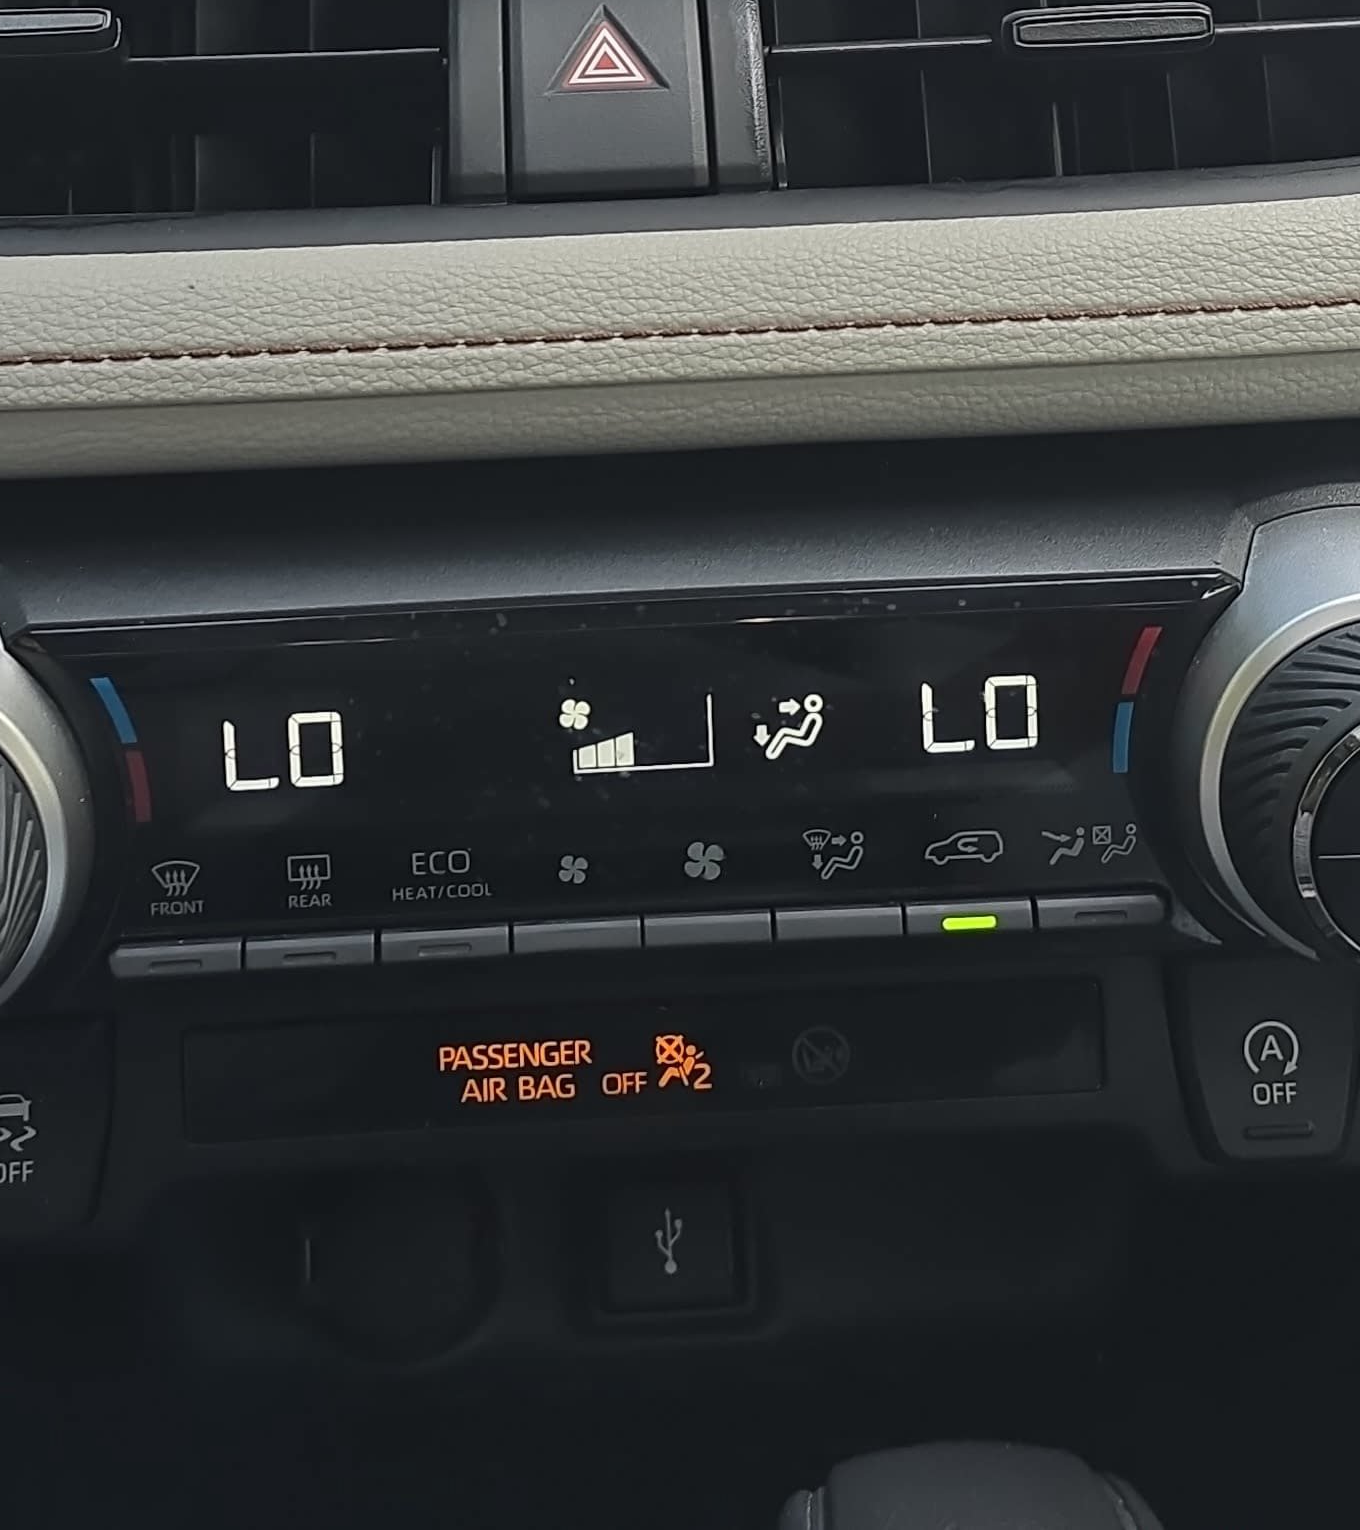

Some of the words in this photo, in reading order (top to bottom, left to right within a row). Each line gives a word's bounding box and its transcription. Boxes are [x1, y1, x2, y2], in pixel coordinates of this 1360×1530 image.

[921, 674, 1038, 754] LO
[222, 711, 344, 791] LO
[411, 850, 471, 876] ECO
[288, 893, 332, 909] REAR
[392, 882, 492, 902] HEAT/COOL
[150, 899, 204, 916] FRONT
[439, 1039, 593, 1071] PASSENGER
[461, 1077, 508, 1103] AIR
[518, 1073, 576, 1101] BAG
[602, 1071, 647, 1095] OFF
[1252, 1082, 1297, 1105] OFF
